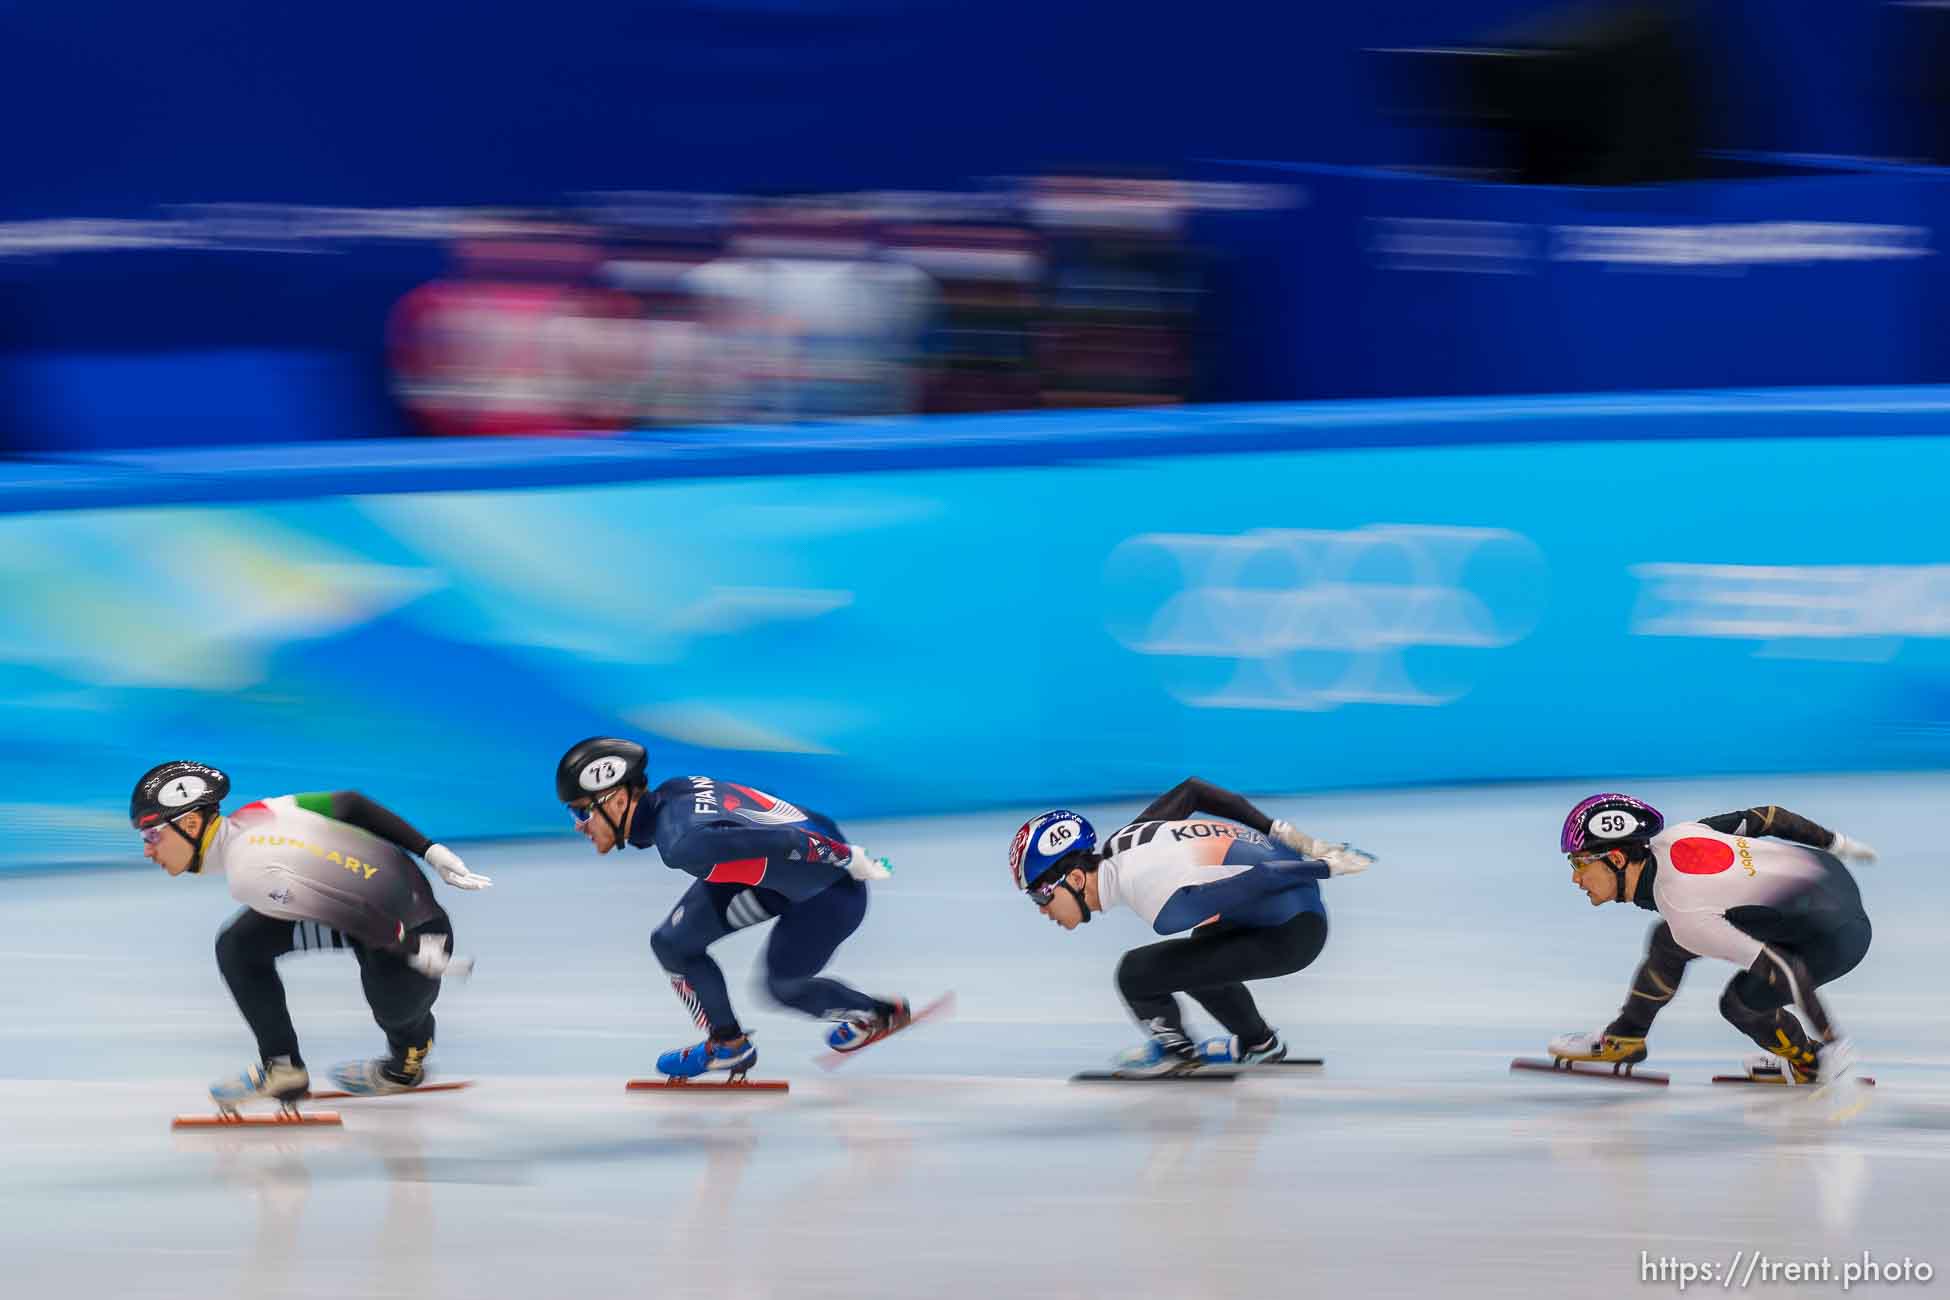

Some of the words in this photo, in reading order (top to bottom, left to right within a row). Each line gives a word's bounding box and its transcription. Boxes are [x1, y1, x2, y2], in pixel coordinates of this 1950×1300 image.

[589, 761, 616, 784] 73
[176, 782, 188, 799] 1
[1601, 815, 1626, 832] 59
[1049, 825, 1072, 848] 46
